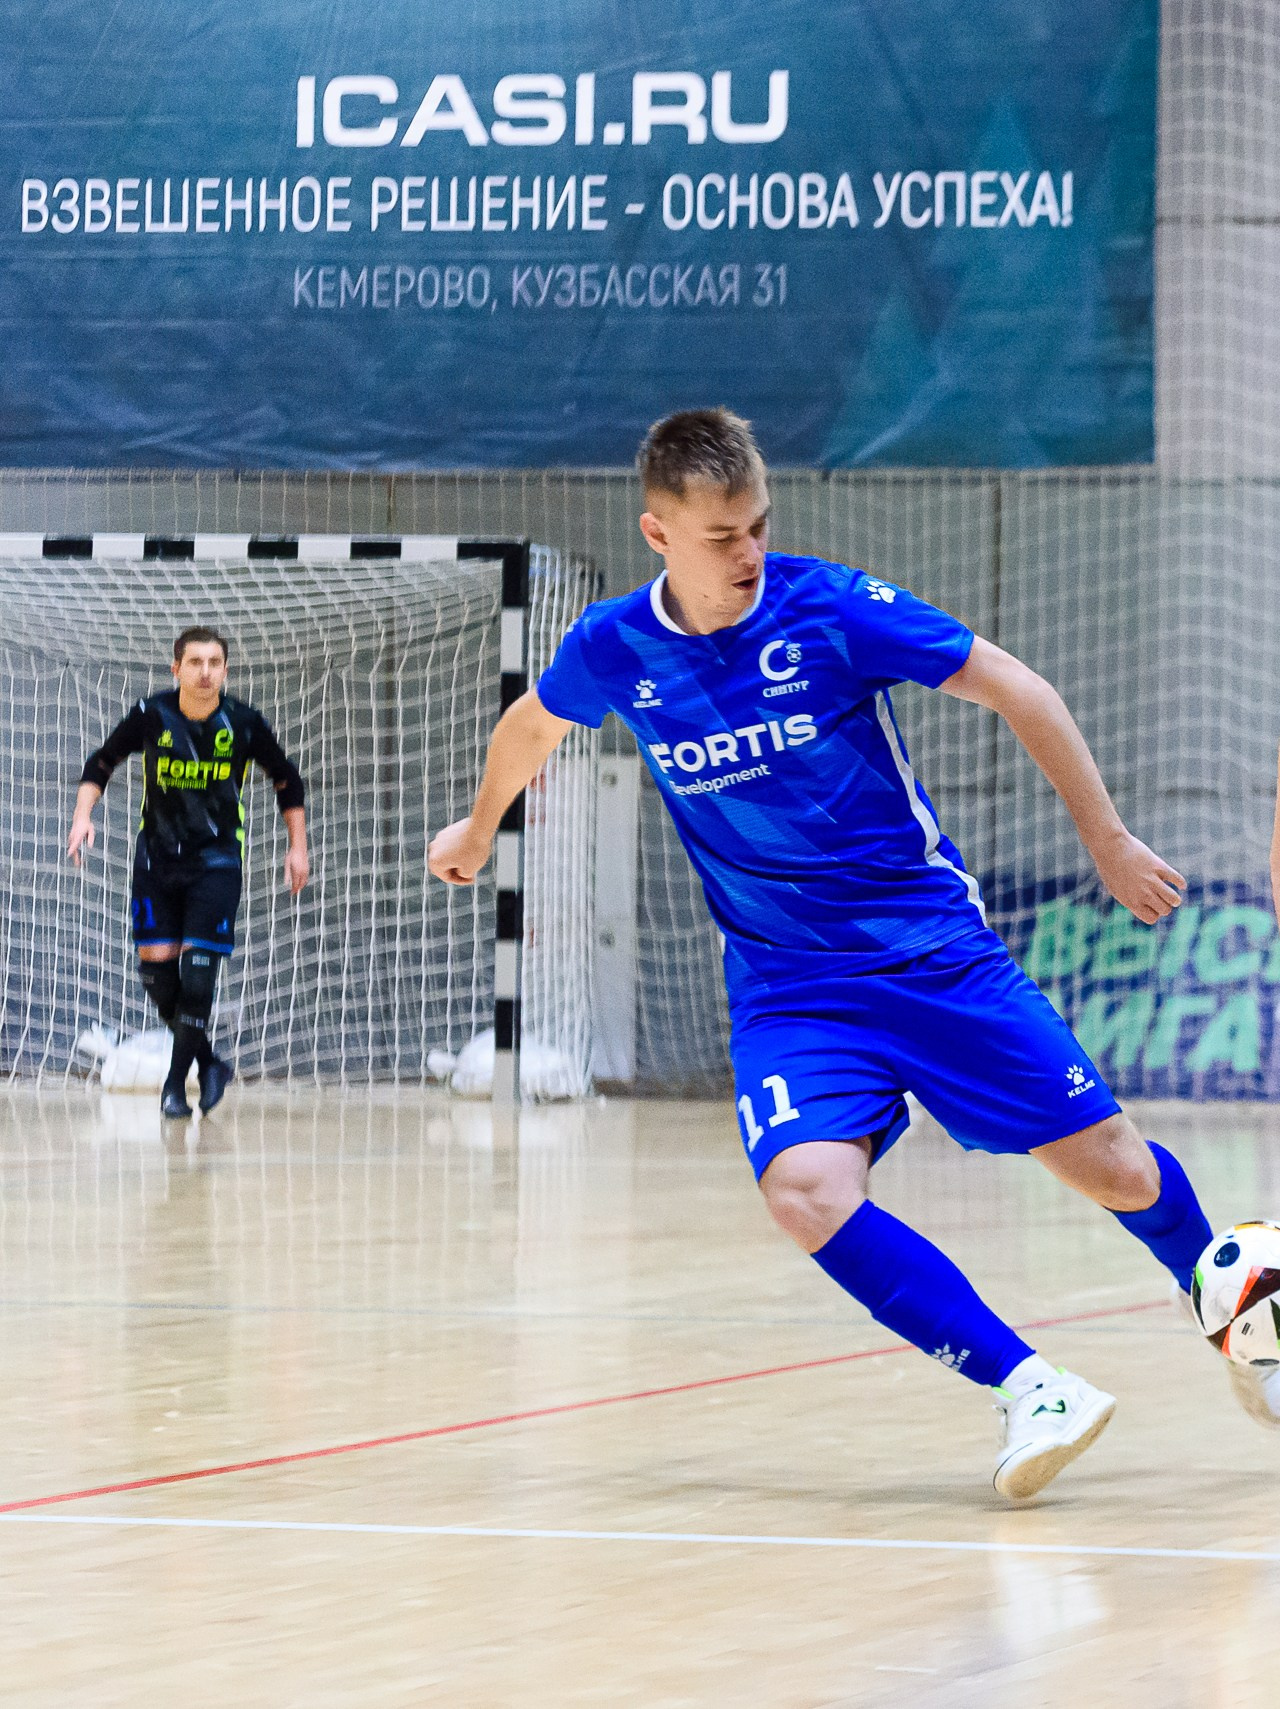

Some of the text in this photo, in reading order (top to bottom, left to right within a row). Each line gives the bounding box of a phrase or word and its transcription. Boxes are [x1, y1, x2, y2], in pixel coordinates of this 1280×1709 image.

[296, 70, 790, 147] ICASI.RU
[20, 177, 352, 233] ВЗВЕШЕННОЕ
[370, 174, 609, 232] РЕШЕНИЕ
[662, 172, 861, 231] ОСНОВА
[872, 170, 1075, 229] УСПЕХА!
[293, 262, 788, 314] КЕМЕРОВО, КУЗБАССКАЯ 31
[648, 714, 818, 774] FORTIS
[1044, 988, 1262, 1073] ИГА
[738, 1074, 801, 1153] 11
[1067, 1079, 1096, 1098] KELME
